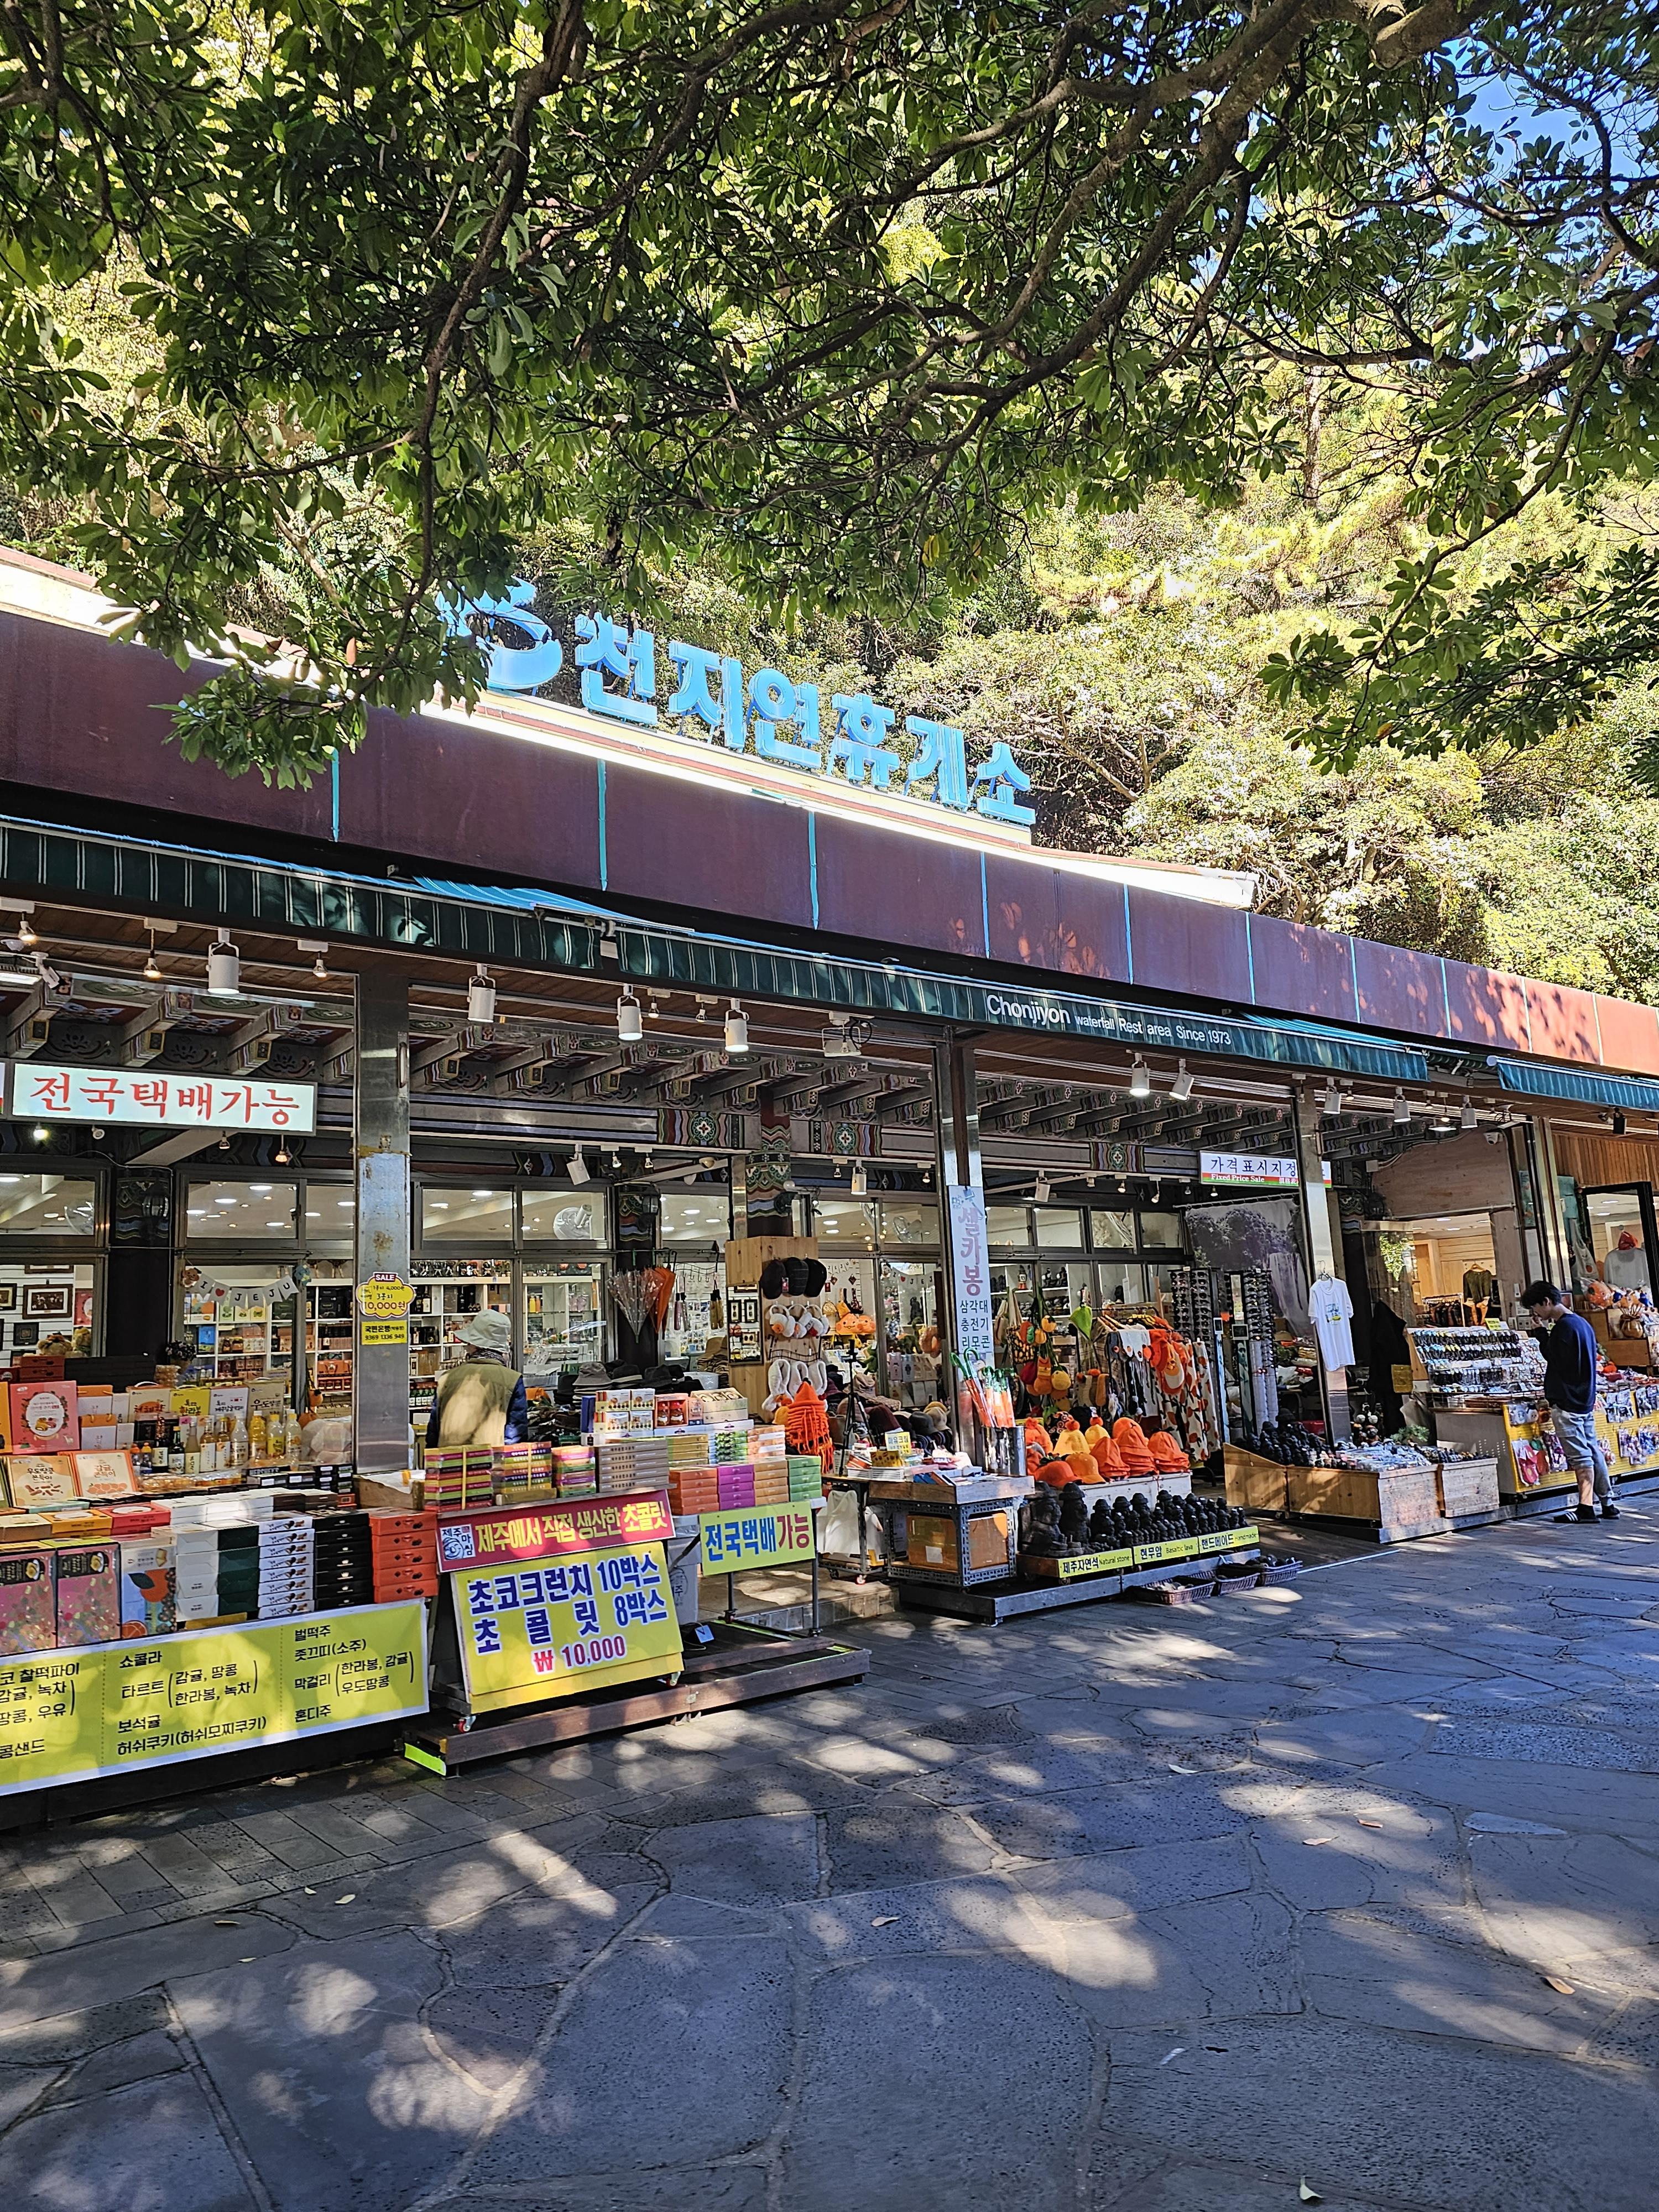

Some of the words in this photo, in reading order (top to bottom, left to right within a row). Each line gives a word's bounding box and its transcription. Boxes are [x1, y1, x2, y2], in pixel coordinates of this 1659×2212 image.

[987, 994, 1071, 1026] Chonjiyon
[1075, 1015, 1115, 1031] waterfall
[1119, 1018, 1143, 1035] Rest
[1147, 1024, 1171, 1037] area
[1176, 1025, 1205, 1042] Since
[1208, 1030, 1230, 1046] 1973
[30, 1072, 300, 1125] 전국택배가능
[1211, 1173, 1230, 1181] Fixed
[1232, 1175, 1249, 1183] Price
[364, 1301, 405, 1311] 10,000원
[960, 1300, 989, 1314] 삼각대
[961, 1317, 989, 1332] 충전기
[962, 1335, 990, 1350] 리모콘
[475, 1517, 542, 1553] 제주에서
[542, 1513, 576, 1543] 직접
[577, 1507, 622, 1540] 생산한
[622, 1501, 668, 1533] 초콜릿
[705, 1513, 810, 1562] 전국택배가능
[1201, 1533, 1234, 1550] 핸드메이드
[1140, 1546, 1162, 1561] 현무암
[1062, 1557, 1099, 1574] 제주자연석
[1099, 1556, 1116, 1566] Natural
[1117, 1555, 1130, 1563] stone
[468, 1563, 593, 1615] 초코크런치
[597, 1553, 661, 1593] 10박스
[614, 1590, 667, 1627] 8박스
[295, 1625, 331, 1642] 벌떡주
[119, 1651, 163, 1668] 쇼콜라
[561, 1635, 626, 1668] 10,000
[19, 1662, 80, 1683] 찰떡파이
[295, 1673, 331, 1691] 막걸리
[122, 1681, 164, 1699] 타르트
[341, 1675, 390, 1694] 우도땅콩
[295, 1704, 332, 1723] 혼디주
[118, 1714, 161, 1734] 보석귤
